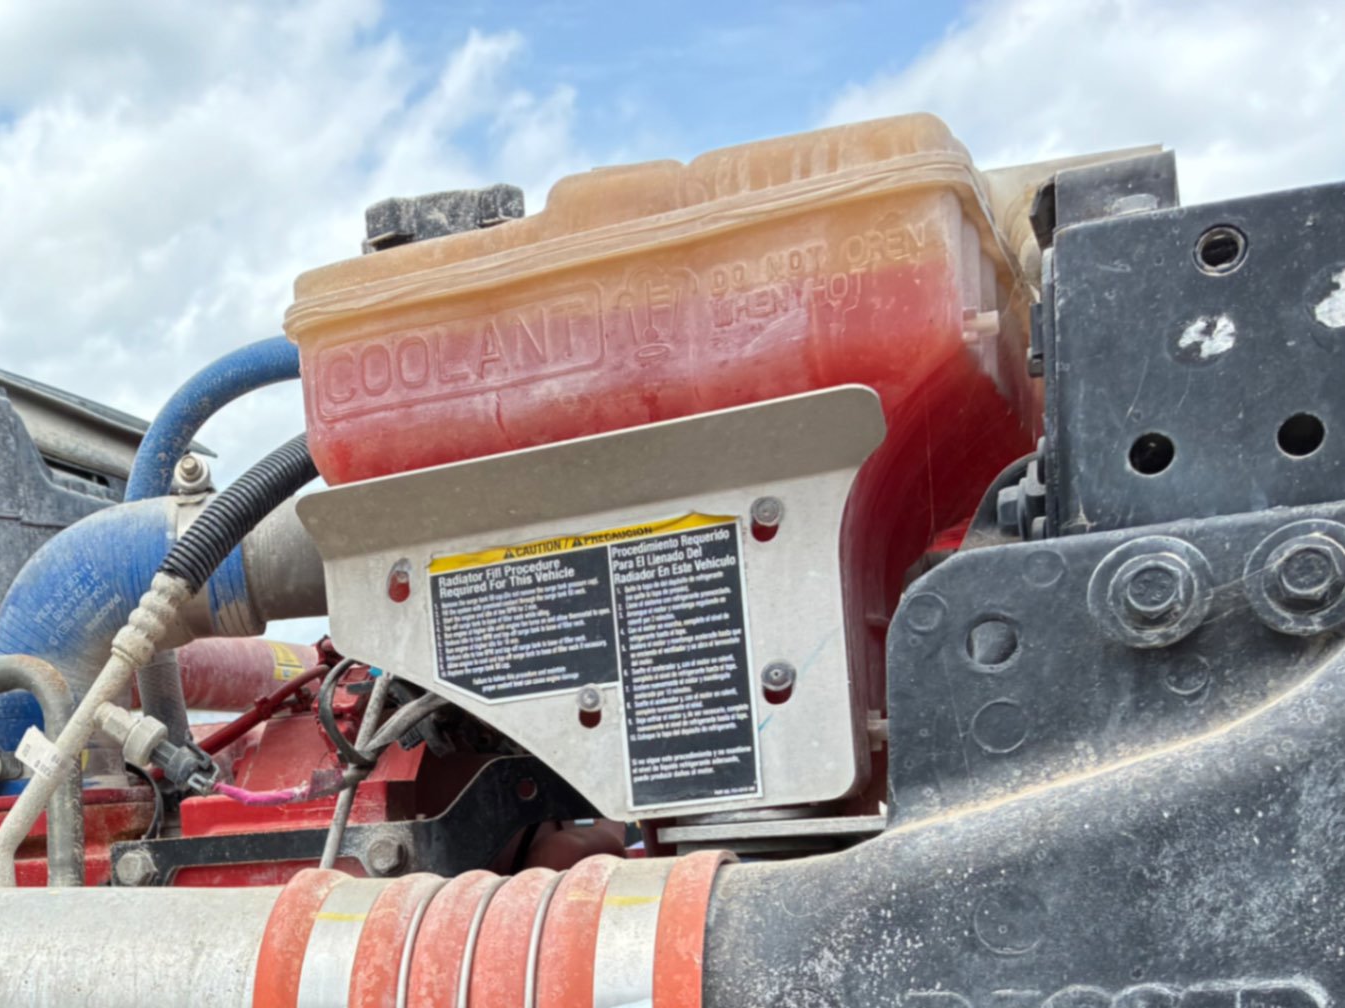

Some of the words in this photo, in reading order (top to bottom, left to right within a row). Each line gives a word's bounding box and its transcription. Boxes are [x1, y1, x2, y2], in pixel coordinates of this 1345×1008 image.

[712, 263, 747, 297] DO
[766, 240, 828, 279] NOT
[804, 267, 867, 302] HOT
[324, 298, 590, 404] COOLANT
[516, 540, 562, 559] CAUTION
[611, 535, 678, 558] Procedimiento
[680, 528, 729, 548] Requerido
[612, 556, 634, 571] Para
[635, 555, 644, 566] El
[646, 548, 684, 566] Llenado
[686, 545, 702, 558] Del
[438, 570, 483, 587] Radiator
[485, 566, 501, 579] Fill
[503, 557, 560, 576] Procedure
[439, 580, 487, 600] Required
[489, 576, 505, 589] For
[509, 572, 532, 586] This
[535, 565, 575, 582] Vehicle
[613, 566, 655, 584] Radiador
[657, 564, 669, 577] En
[671, 560, 692, 575] Este
